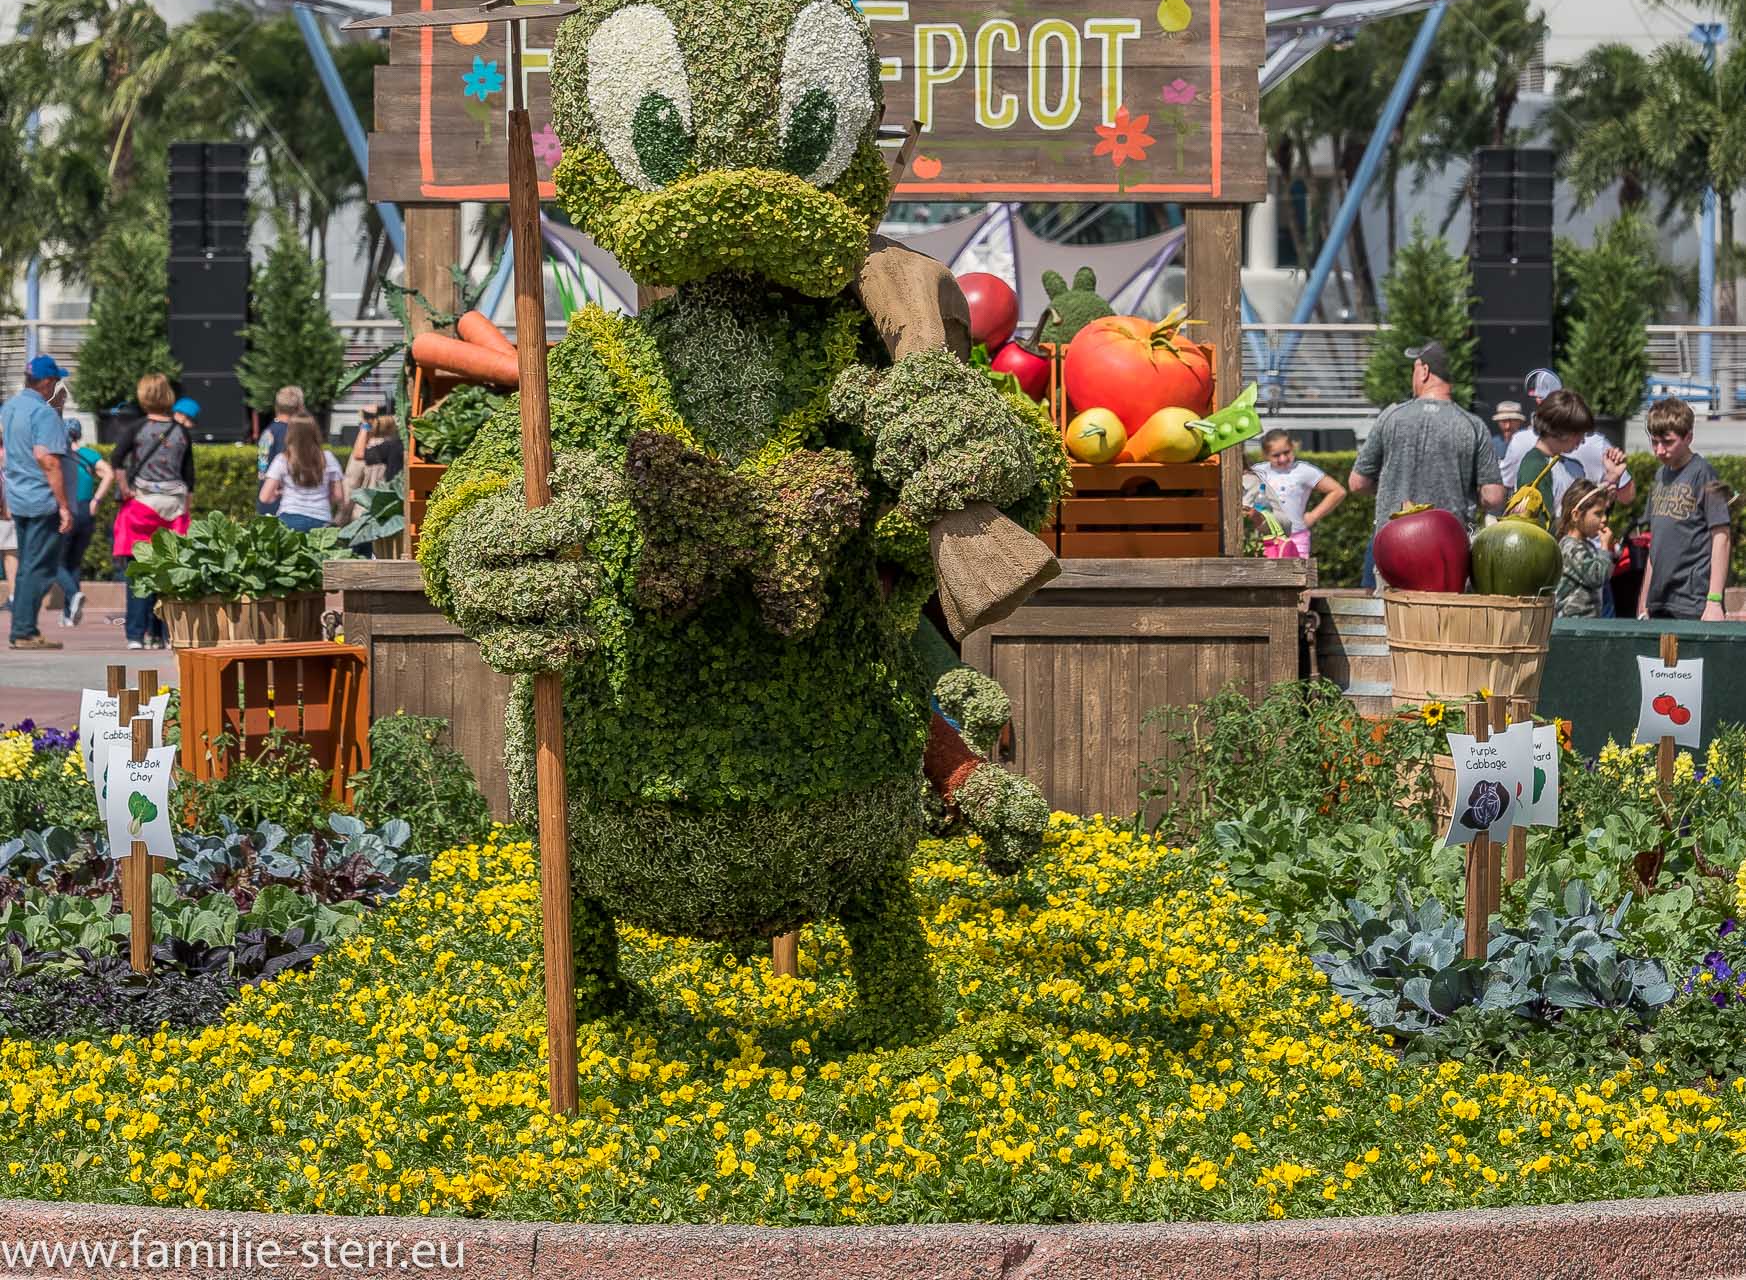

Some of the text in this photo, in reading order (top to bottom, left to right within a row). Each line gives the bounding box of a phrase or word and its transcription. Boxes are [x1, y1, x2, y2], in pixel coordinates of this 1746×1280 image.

[1650, 483, 1696, 500] TAR
[1650, 669, 1693, 680] Tomatoes
[88, 709, 118, 719] Cabbag
[103, 730, 134, 741] Cabbag
[1470, 746, 1498, 756] Purple
[1533, 752, 1552, 762] ard
[144, 759, 161, 769] Bok
[1465, 759, 1508, 771] Cabbage
[130, 771, 153, 784] Choy
